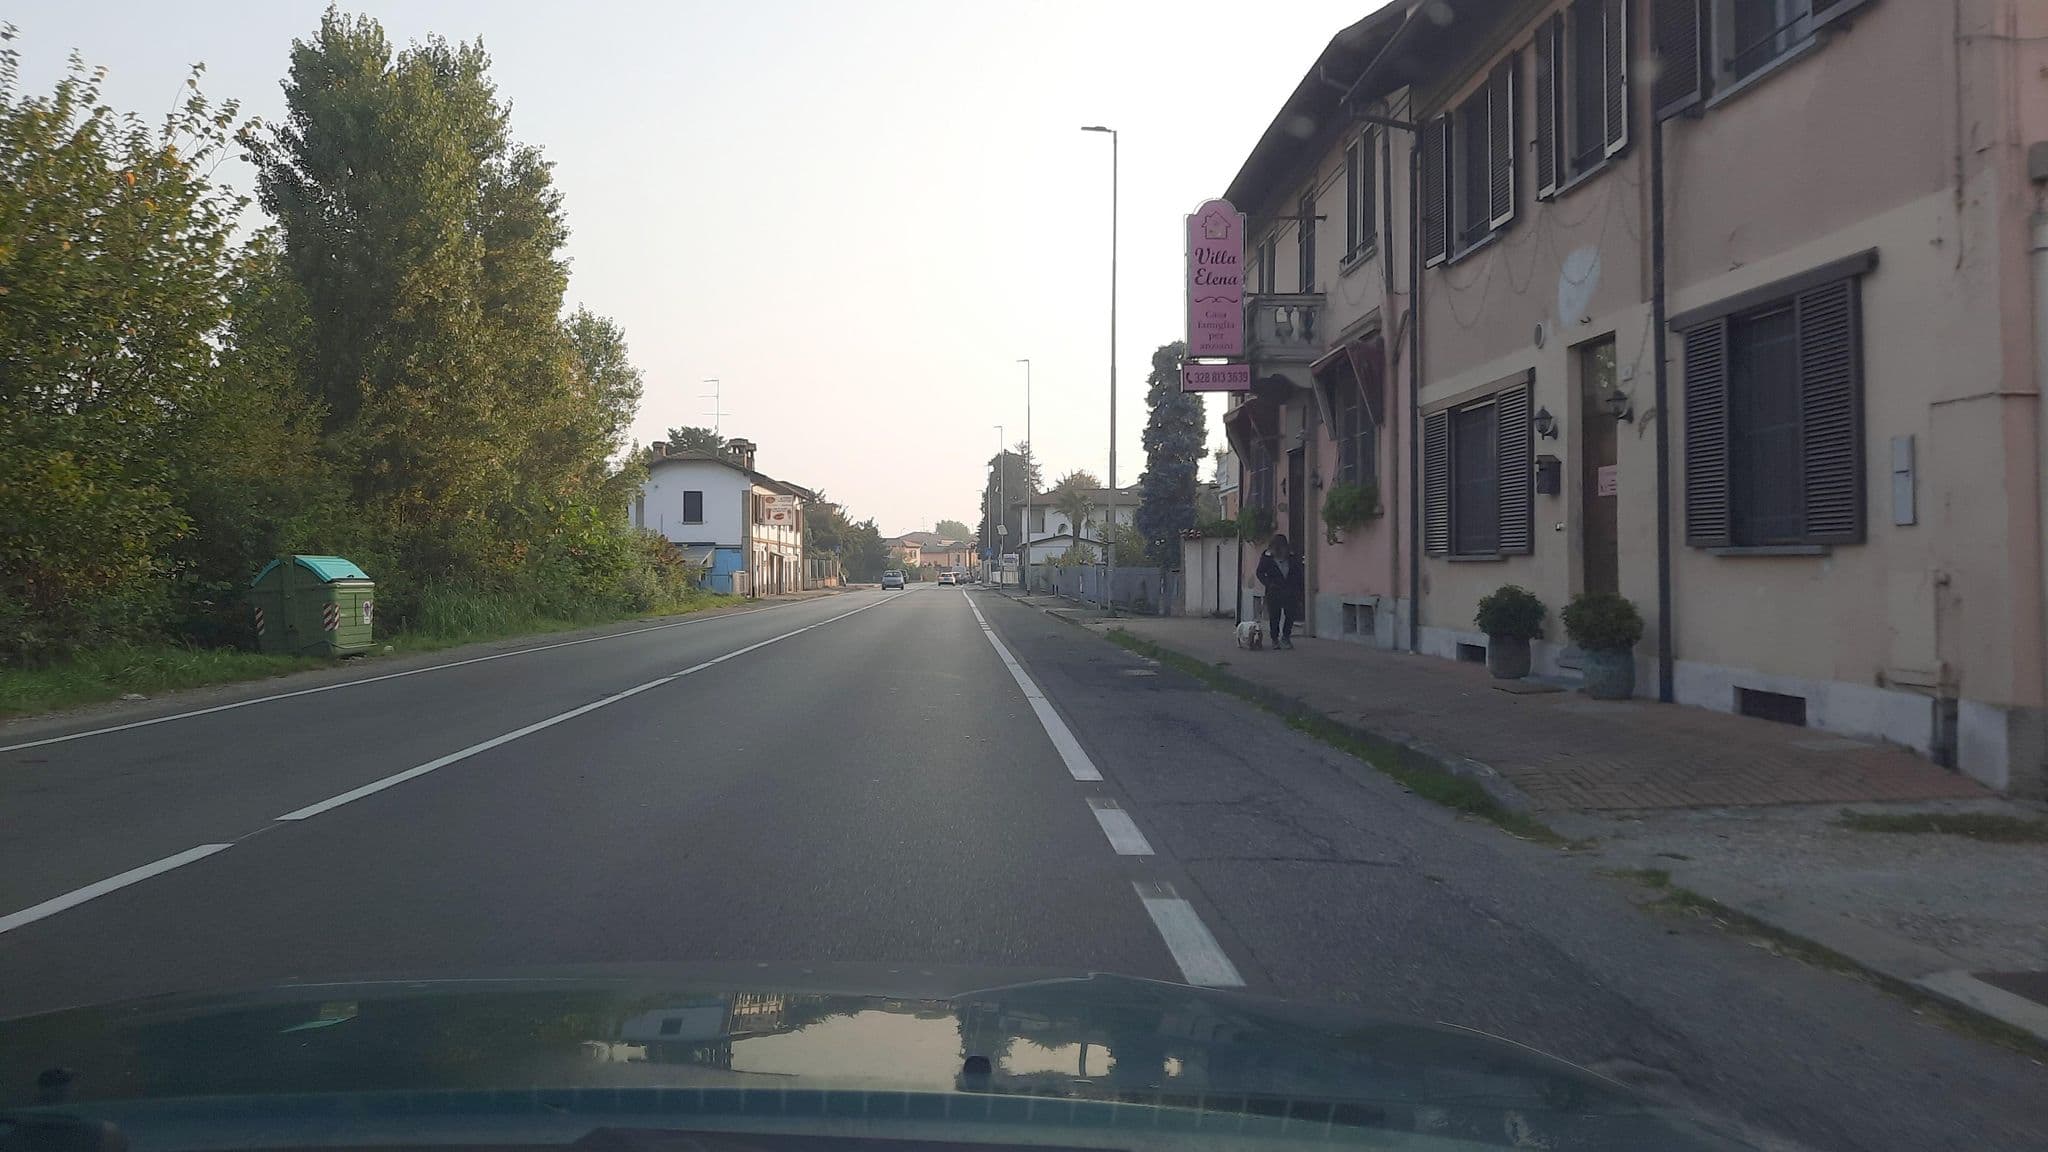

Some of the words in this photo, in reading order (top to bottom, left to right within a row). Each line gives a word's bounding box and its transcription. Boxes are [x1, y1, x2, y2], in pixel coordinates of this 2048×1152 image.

[1195, 247, 1237, 265] Villa
[1195, 268, 1238, 286] Elena
[1194, 372, 1210, 383] 328
[1211, 372, 1226, 383] 813
